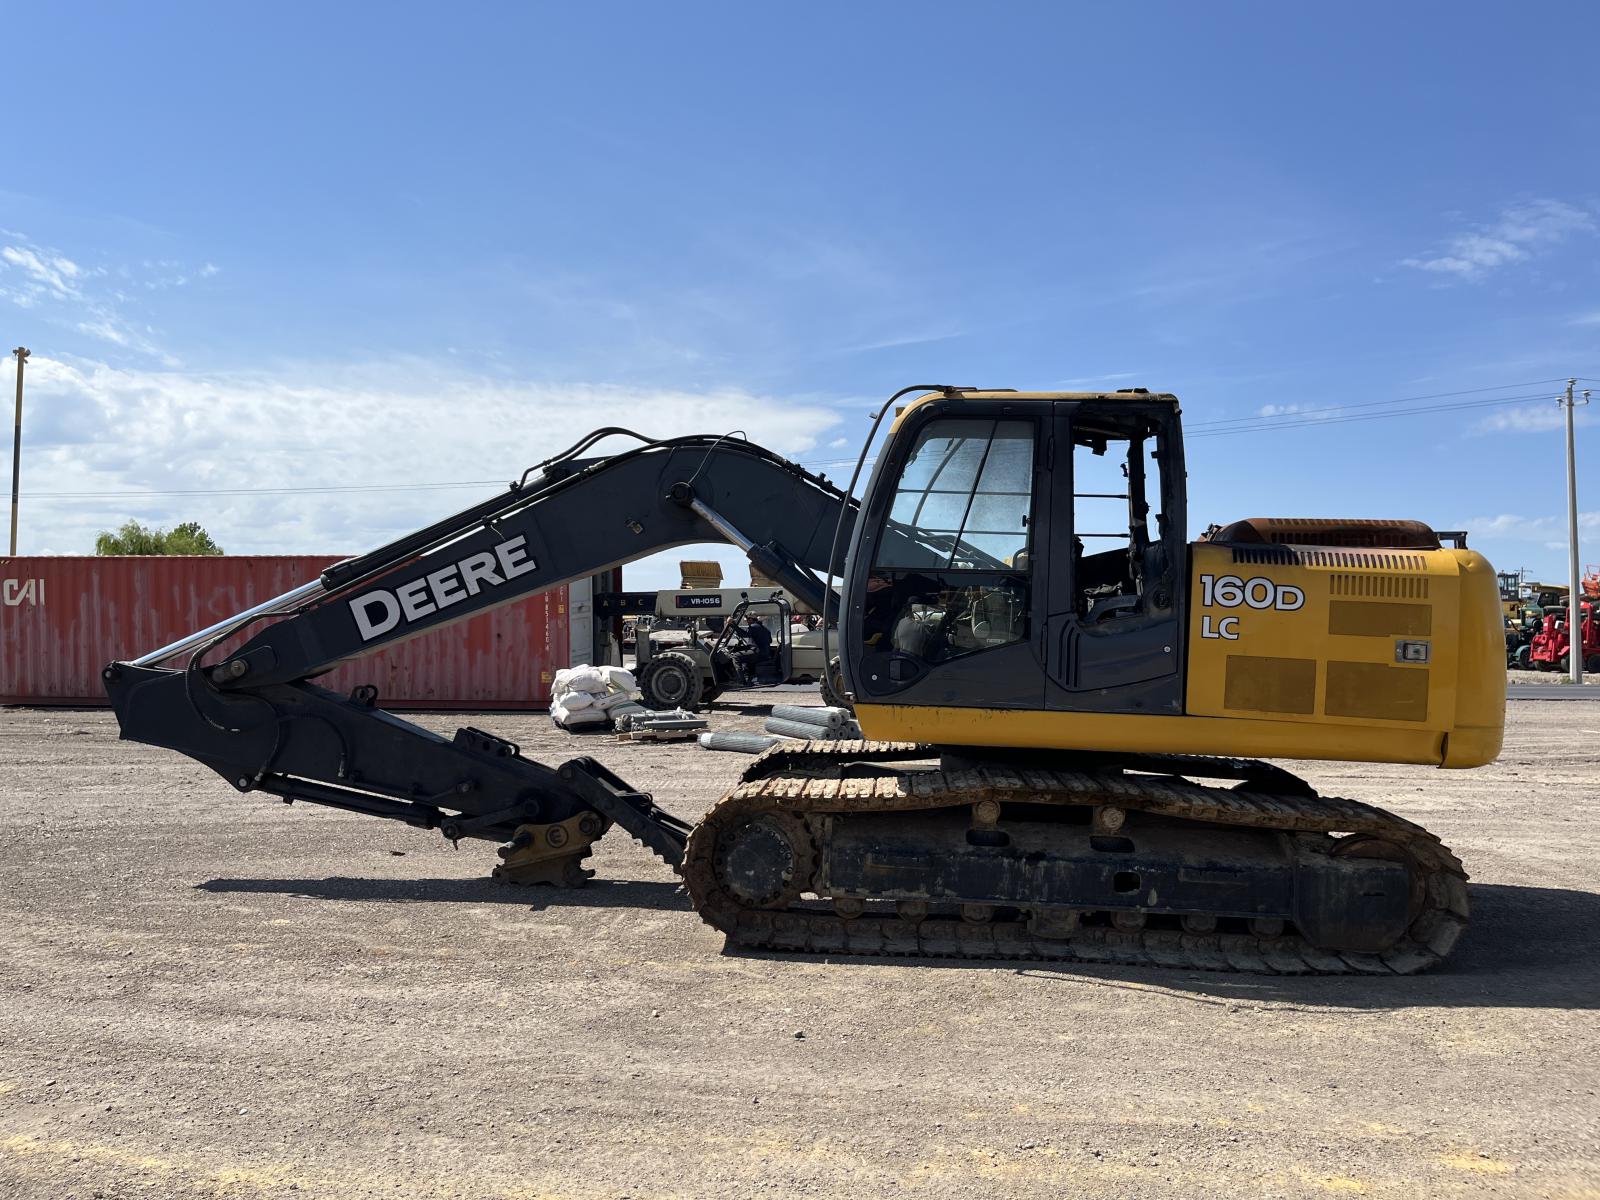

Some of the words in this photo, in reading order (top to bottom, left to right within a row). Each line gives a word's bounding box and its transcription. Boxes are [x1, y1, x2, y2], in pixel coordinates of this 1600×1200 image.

[3, 578, 45, 606] CAI
[349, 535, 536, 641] DEERE
[690, 597, 721, 606] VR-1056
[1200, 574, 1305, 611] 160D
[1201, 615, 1239, 640] LC
